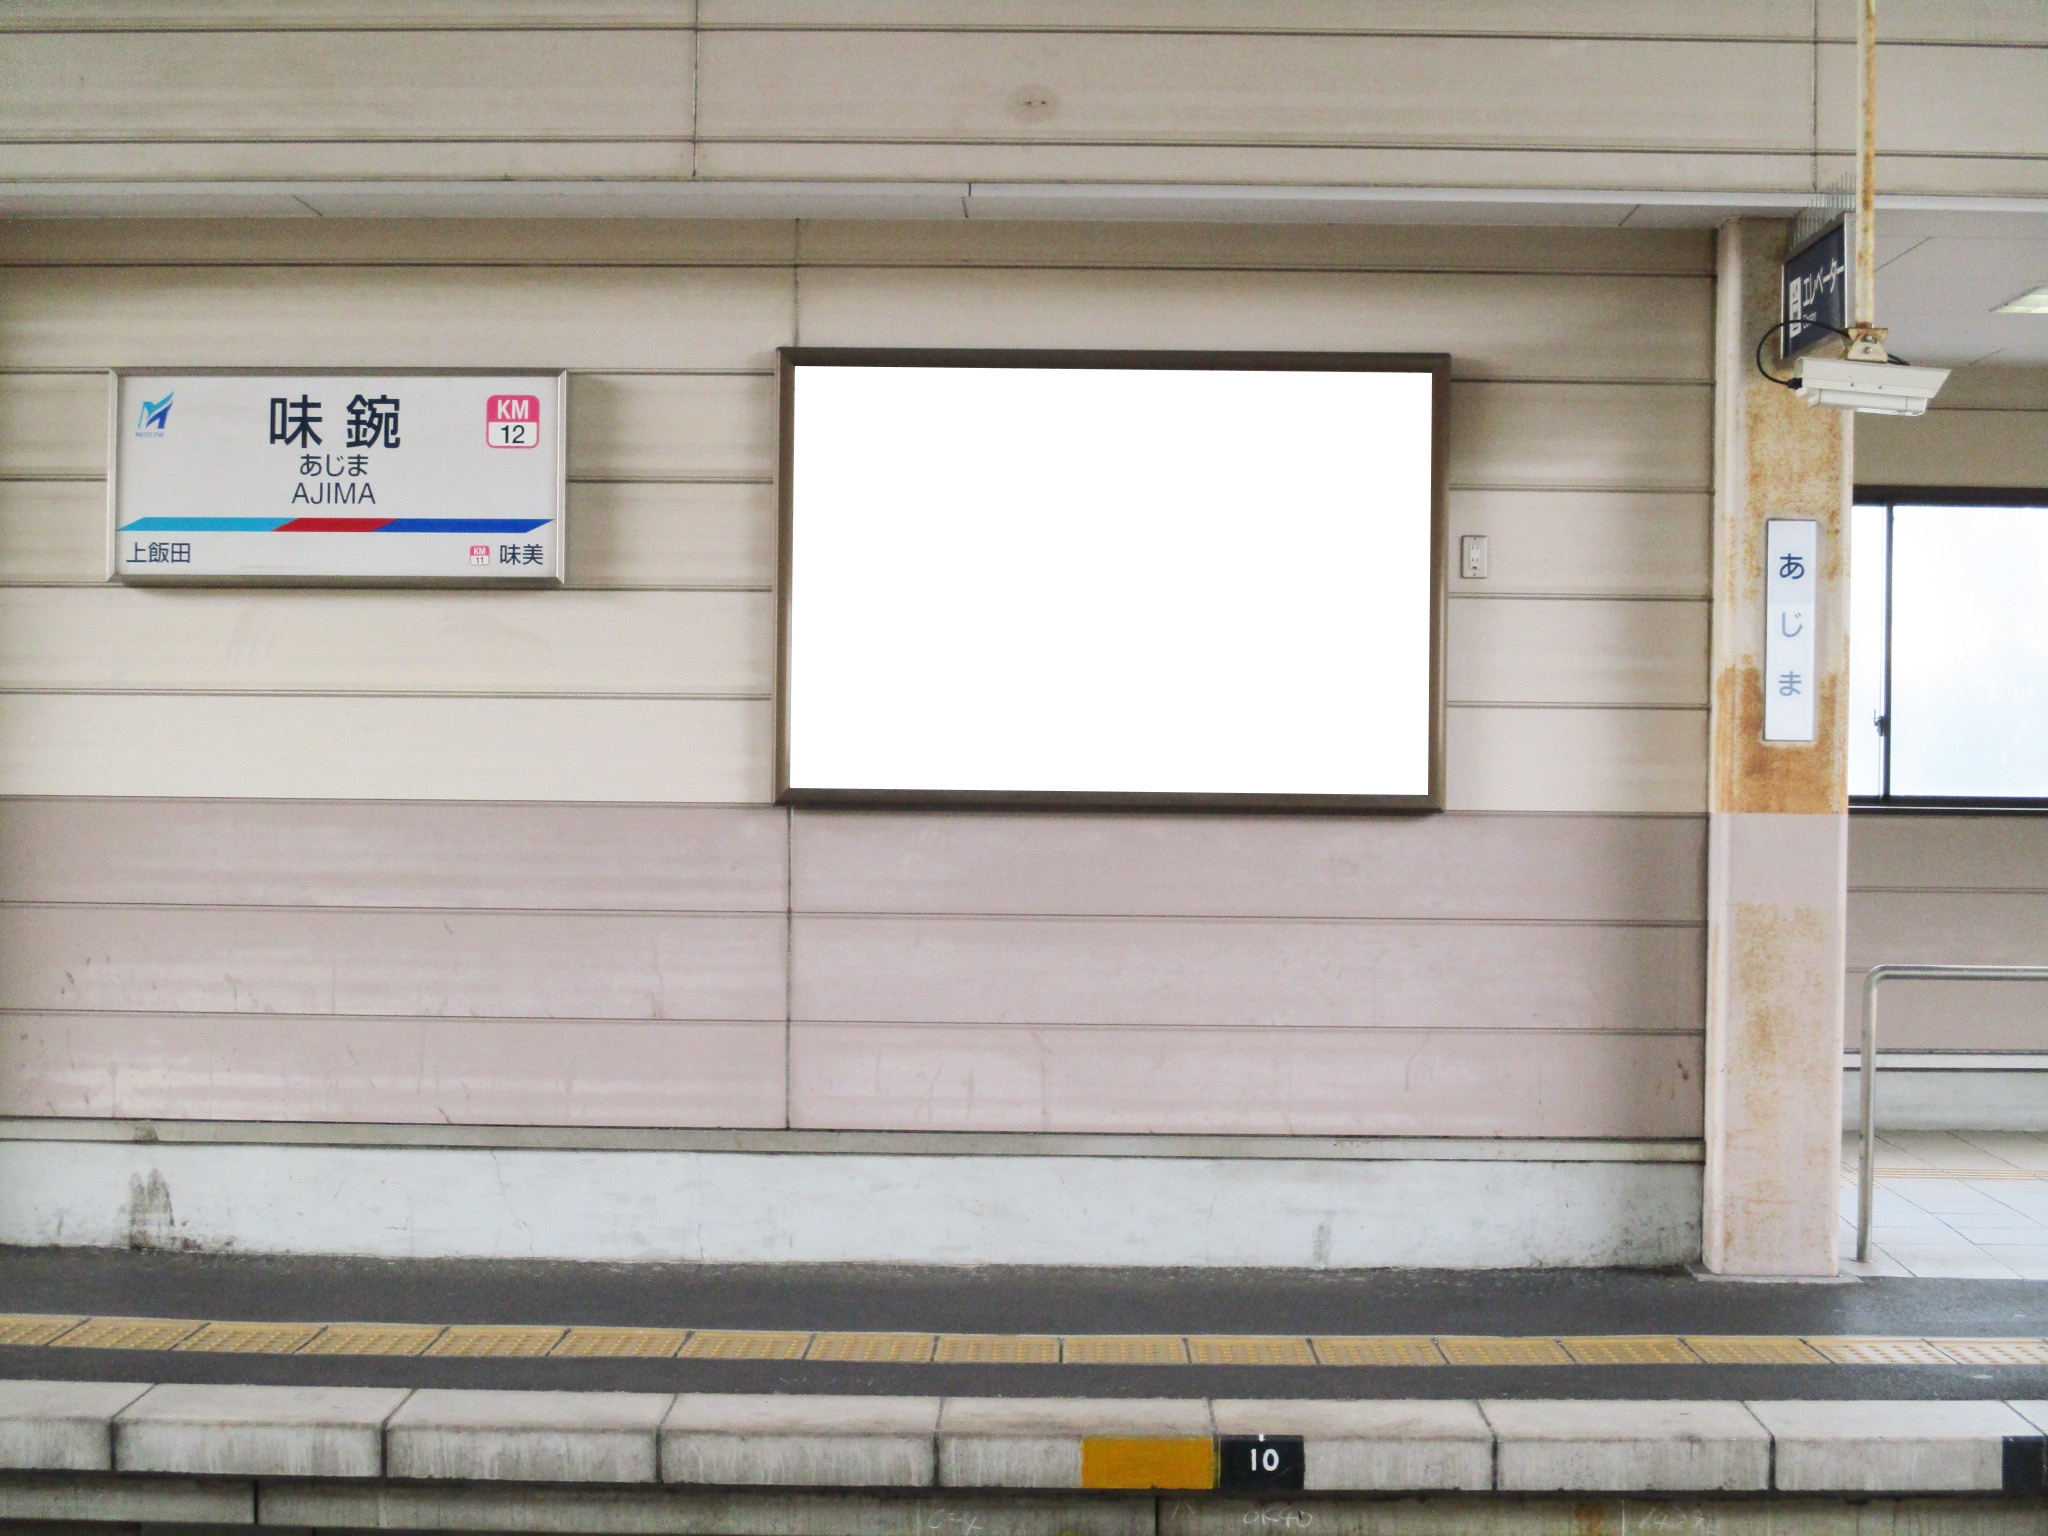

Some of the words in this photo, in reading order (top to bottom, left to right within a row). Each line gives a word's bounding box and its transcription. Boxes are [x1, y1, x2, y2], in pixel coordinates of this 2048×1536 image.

[497, 399, 529, 420] KM
[500, 424, 525, 444] 12
[299, 453, 369, 477] あじま
[291, 482, 376, 505] AJIMA
[126, 541, 191, 564] 上飯田
[473, 547, 486, 555] KM
[475, 556, 484, 564] 11
[499, 543, 544, 566] 味美
[1778, 552, 1805, 697] あじま
[1250, 1448, 1280, 1472] 10
